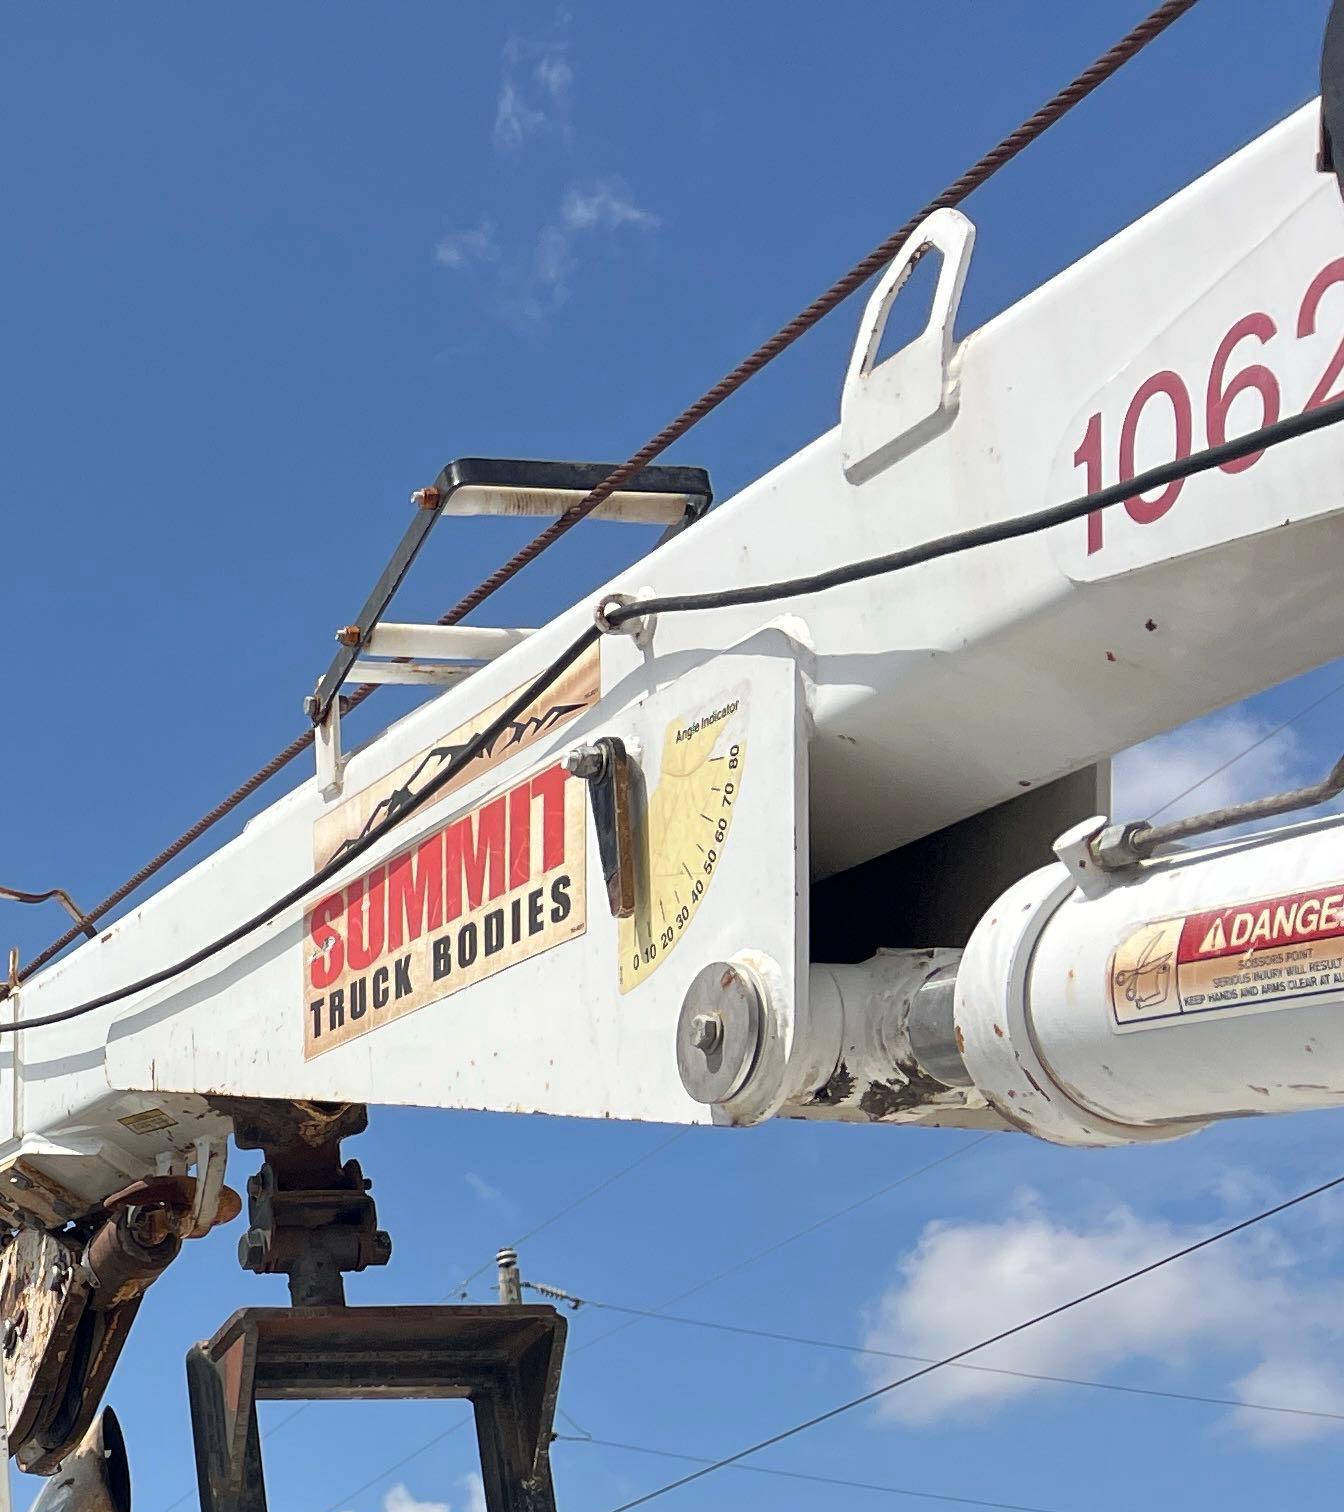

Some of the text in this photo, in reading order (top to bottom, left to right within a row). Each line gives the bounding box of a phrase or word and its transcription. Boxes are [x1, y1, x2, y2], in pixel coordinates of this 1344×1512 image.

[675, 700, 740, 744] Angle Indicator
[729, 744, 740, 770] 80
[722, 782, 734, 807] 70
[715, 817, 727, 843] 60
[703, 849, 717, 875] 50
[309, 762, 573, 989] SUMMIT
[691, 880, 704, 904] 40
[676, 905, 690, 930] 30
[1230, 894, 1344, 946] DANGE
[661, 925, 674, 950] 20
[310, 874, 572, 1039] TRUCK BODIES
[633, 954, 640, 971] 0
[644, 943, 657, 965] 10
[1286, 948, 1313, 963] POINT
[1213, 957, 1343, 988] SERIOUS INJURY WILL RESULT
[1208, 988, 1238, 1003] HANDS
[1240, 985, 1258, 998] AND
[1261, 981, 1286, 995] ARMS
[1287, 976, 1318, 990] CLEAR
[1319, 973, 1330, 985] AT
